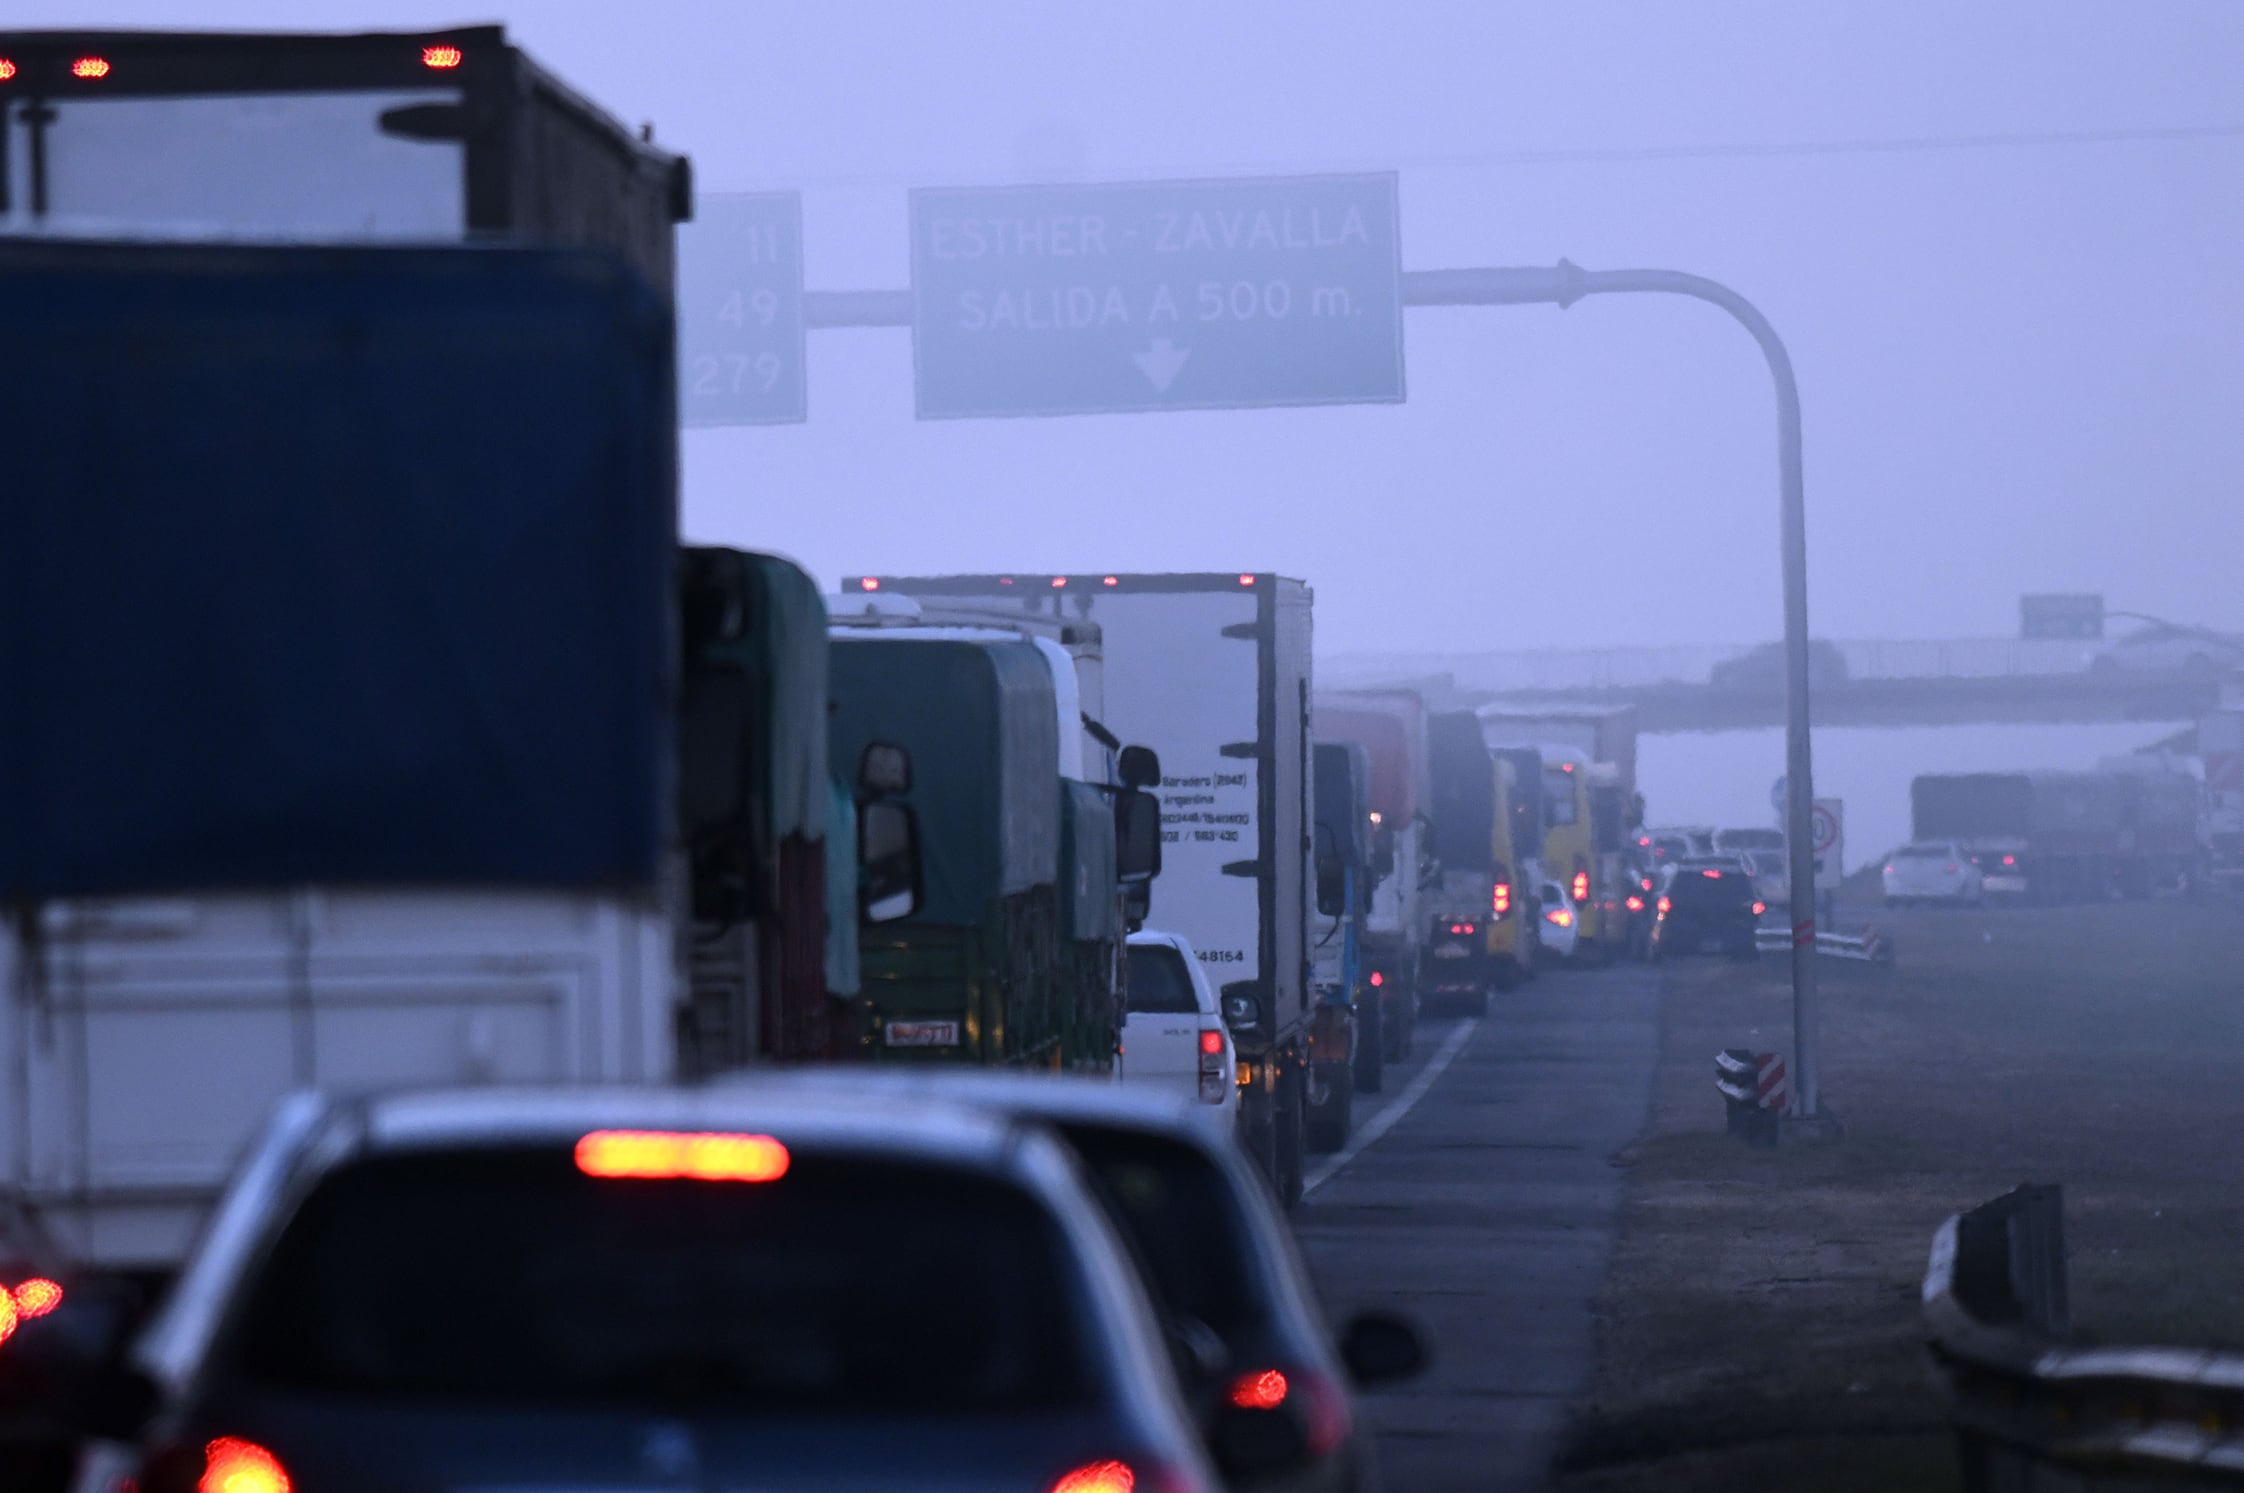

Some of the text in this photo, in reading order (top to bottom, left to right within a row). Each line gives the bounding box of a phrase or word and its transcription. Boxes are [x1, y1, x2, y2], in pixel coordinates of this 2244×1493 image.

[747, 223, 777, 264] 11
[929, 213, 1107, 259] ESTHER
[1154, 204, 1369, 253] ZAVALLA
[717, 288, 779, 329] 49
[959, 279, 1363, 331] SALIDA A 500 m.
[692, 351, 781, 396] 279
